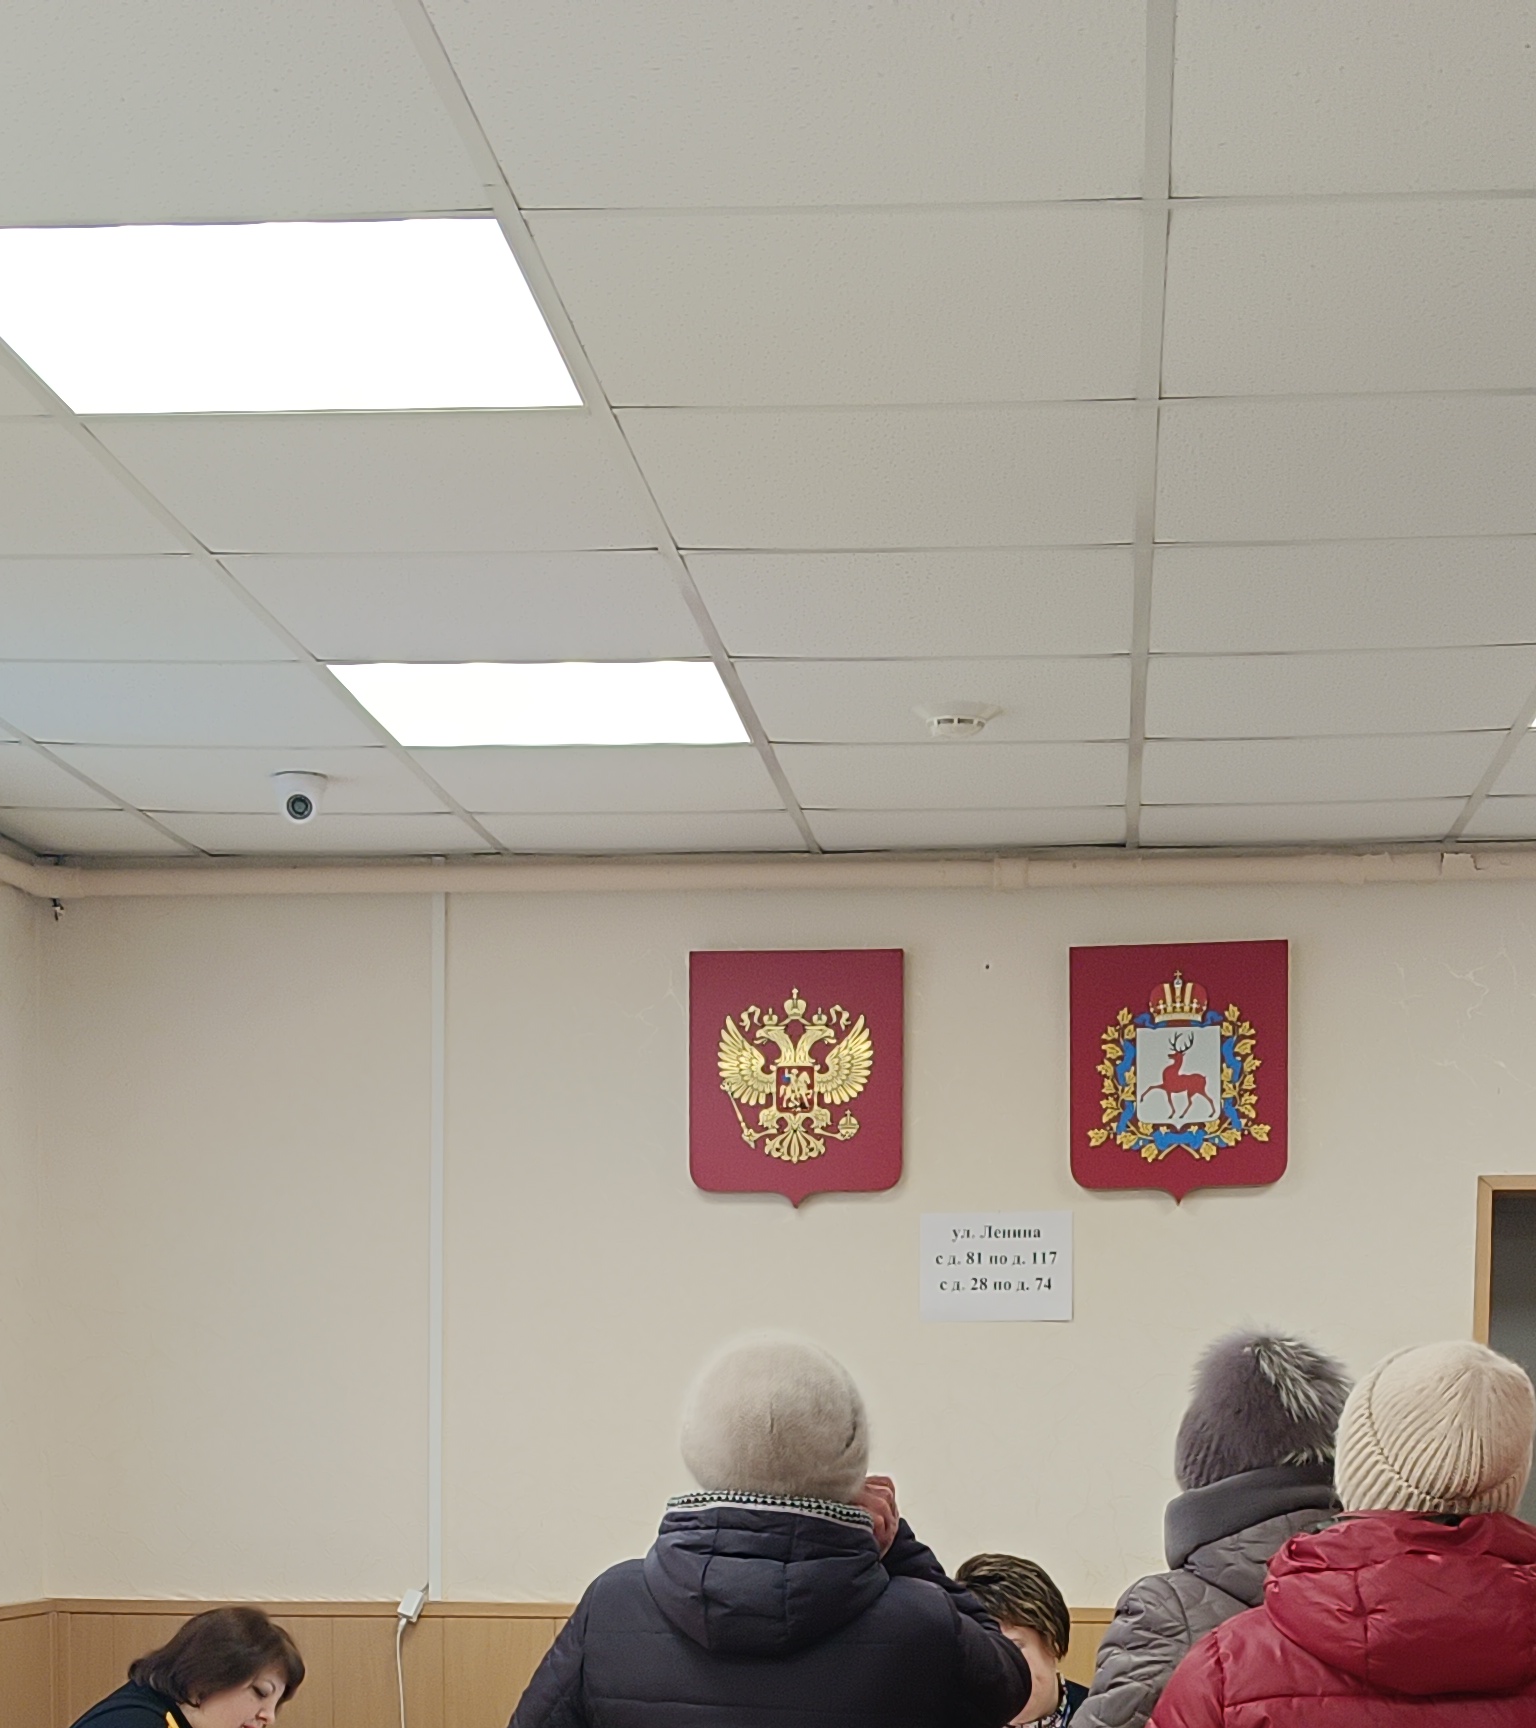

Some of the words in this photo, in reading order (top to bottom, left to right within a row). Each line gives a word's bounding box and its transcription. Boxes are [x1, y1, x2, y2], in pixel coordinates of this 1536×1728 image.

[951, 1228, 976, 1243] ул.
[979, 1224, 1042, 1240] Ленина
[935, 1254, 944, 1266] с
[946, 1254, 962, 1267] д.
[966, 1250, 982, 1266] 81
[988, 1254, 1008, 1266] по
[1011, 1254, 1026, 1267] д.
[1032, 1250, 1058, 1266] 117
[939, 1280, 949, 1292] с
[950, 1280, 966, 1293] д.
[969, 1276, 989, 1292] 28
[993, 1280, 1012, 1292] по
[1015, 1280, 1031, 1293] д.
[1034, 1276, 1052, 1292] 74
